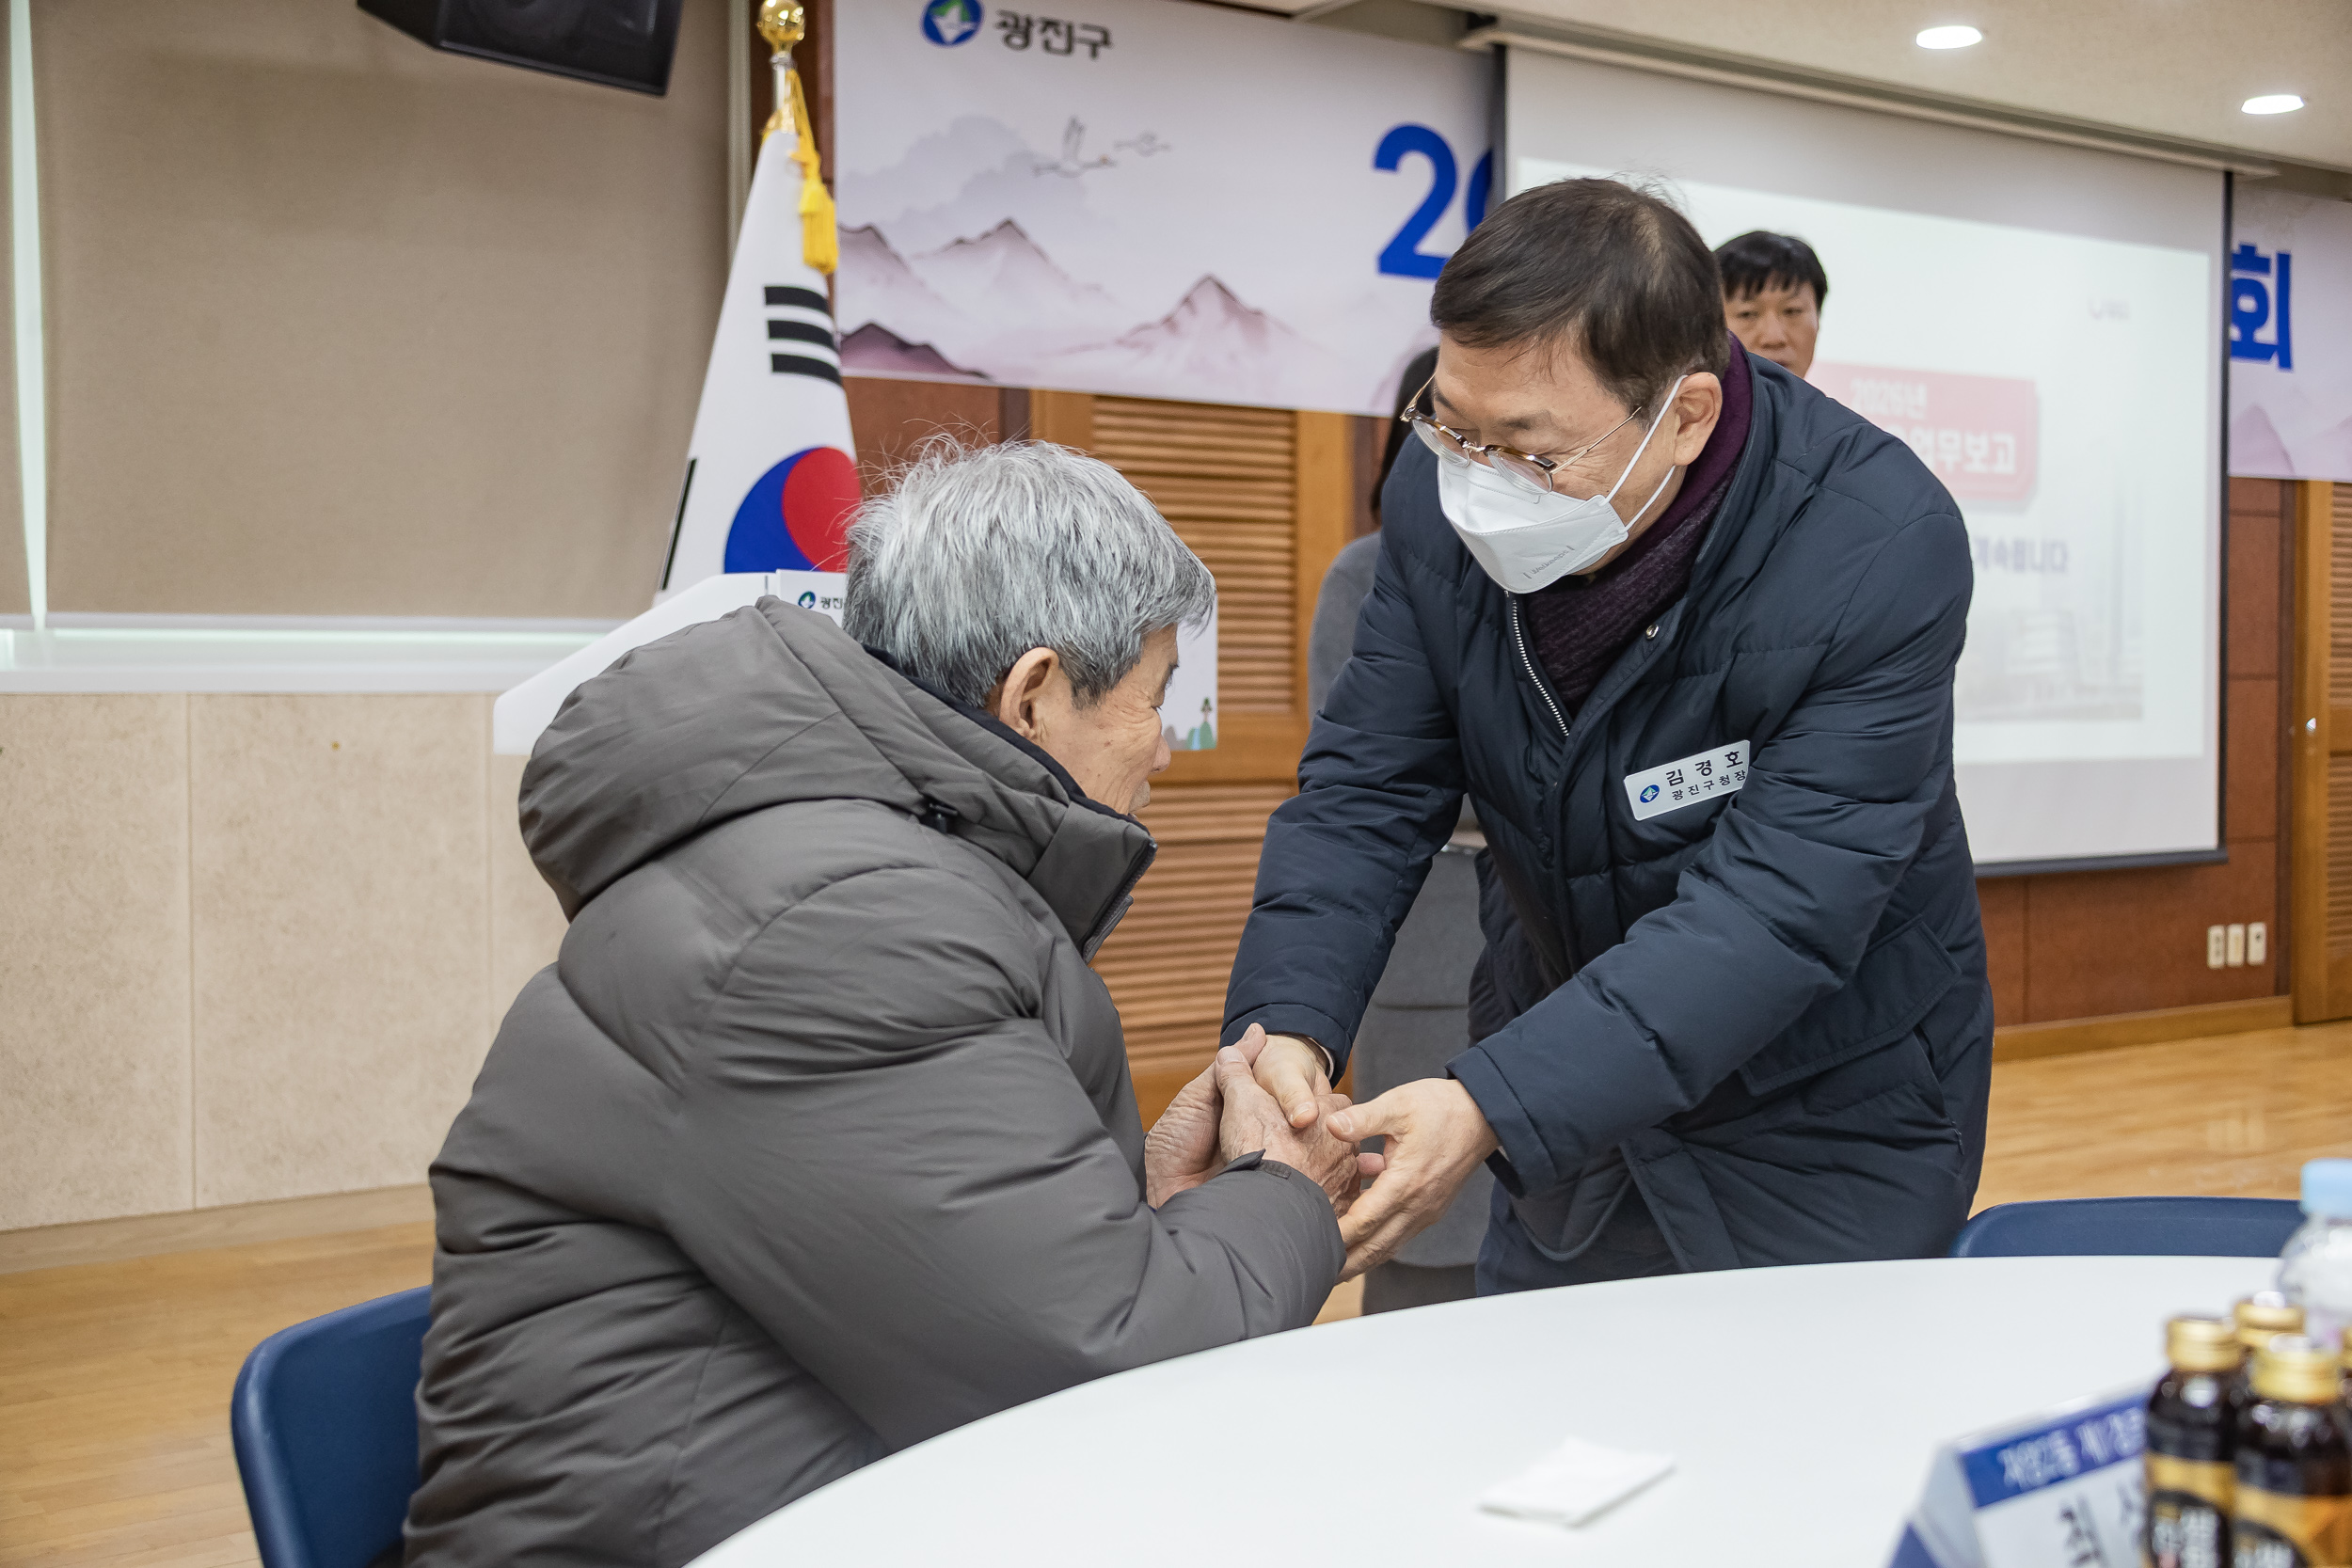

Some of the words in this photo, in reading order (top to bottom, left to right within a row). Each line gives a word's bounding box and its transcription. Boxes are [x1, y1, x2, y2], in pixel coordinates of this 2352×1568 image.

[995, 8, 1111, 60] 광진구
[1374, 123, 1493, 280] 2
[2230, 243, 2293, 370] 회
[1671, 769, 1746, 800] 광진구청장
